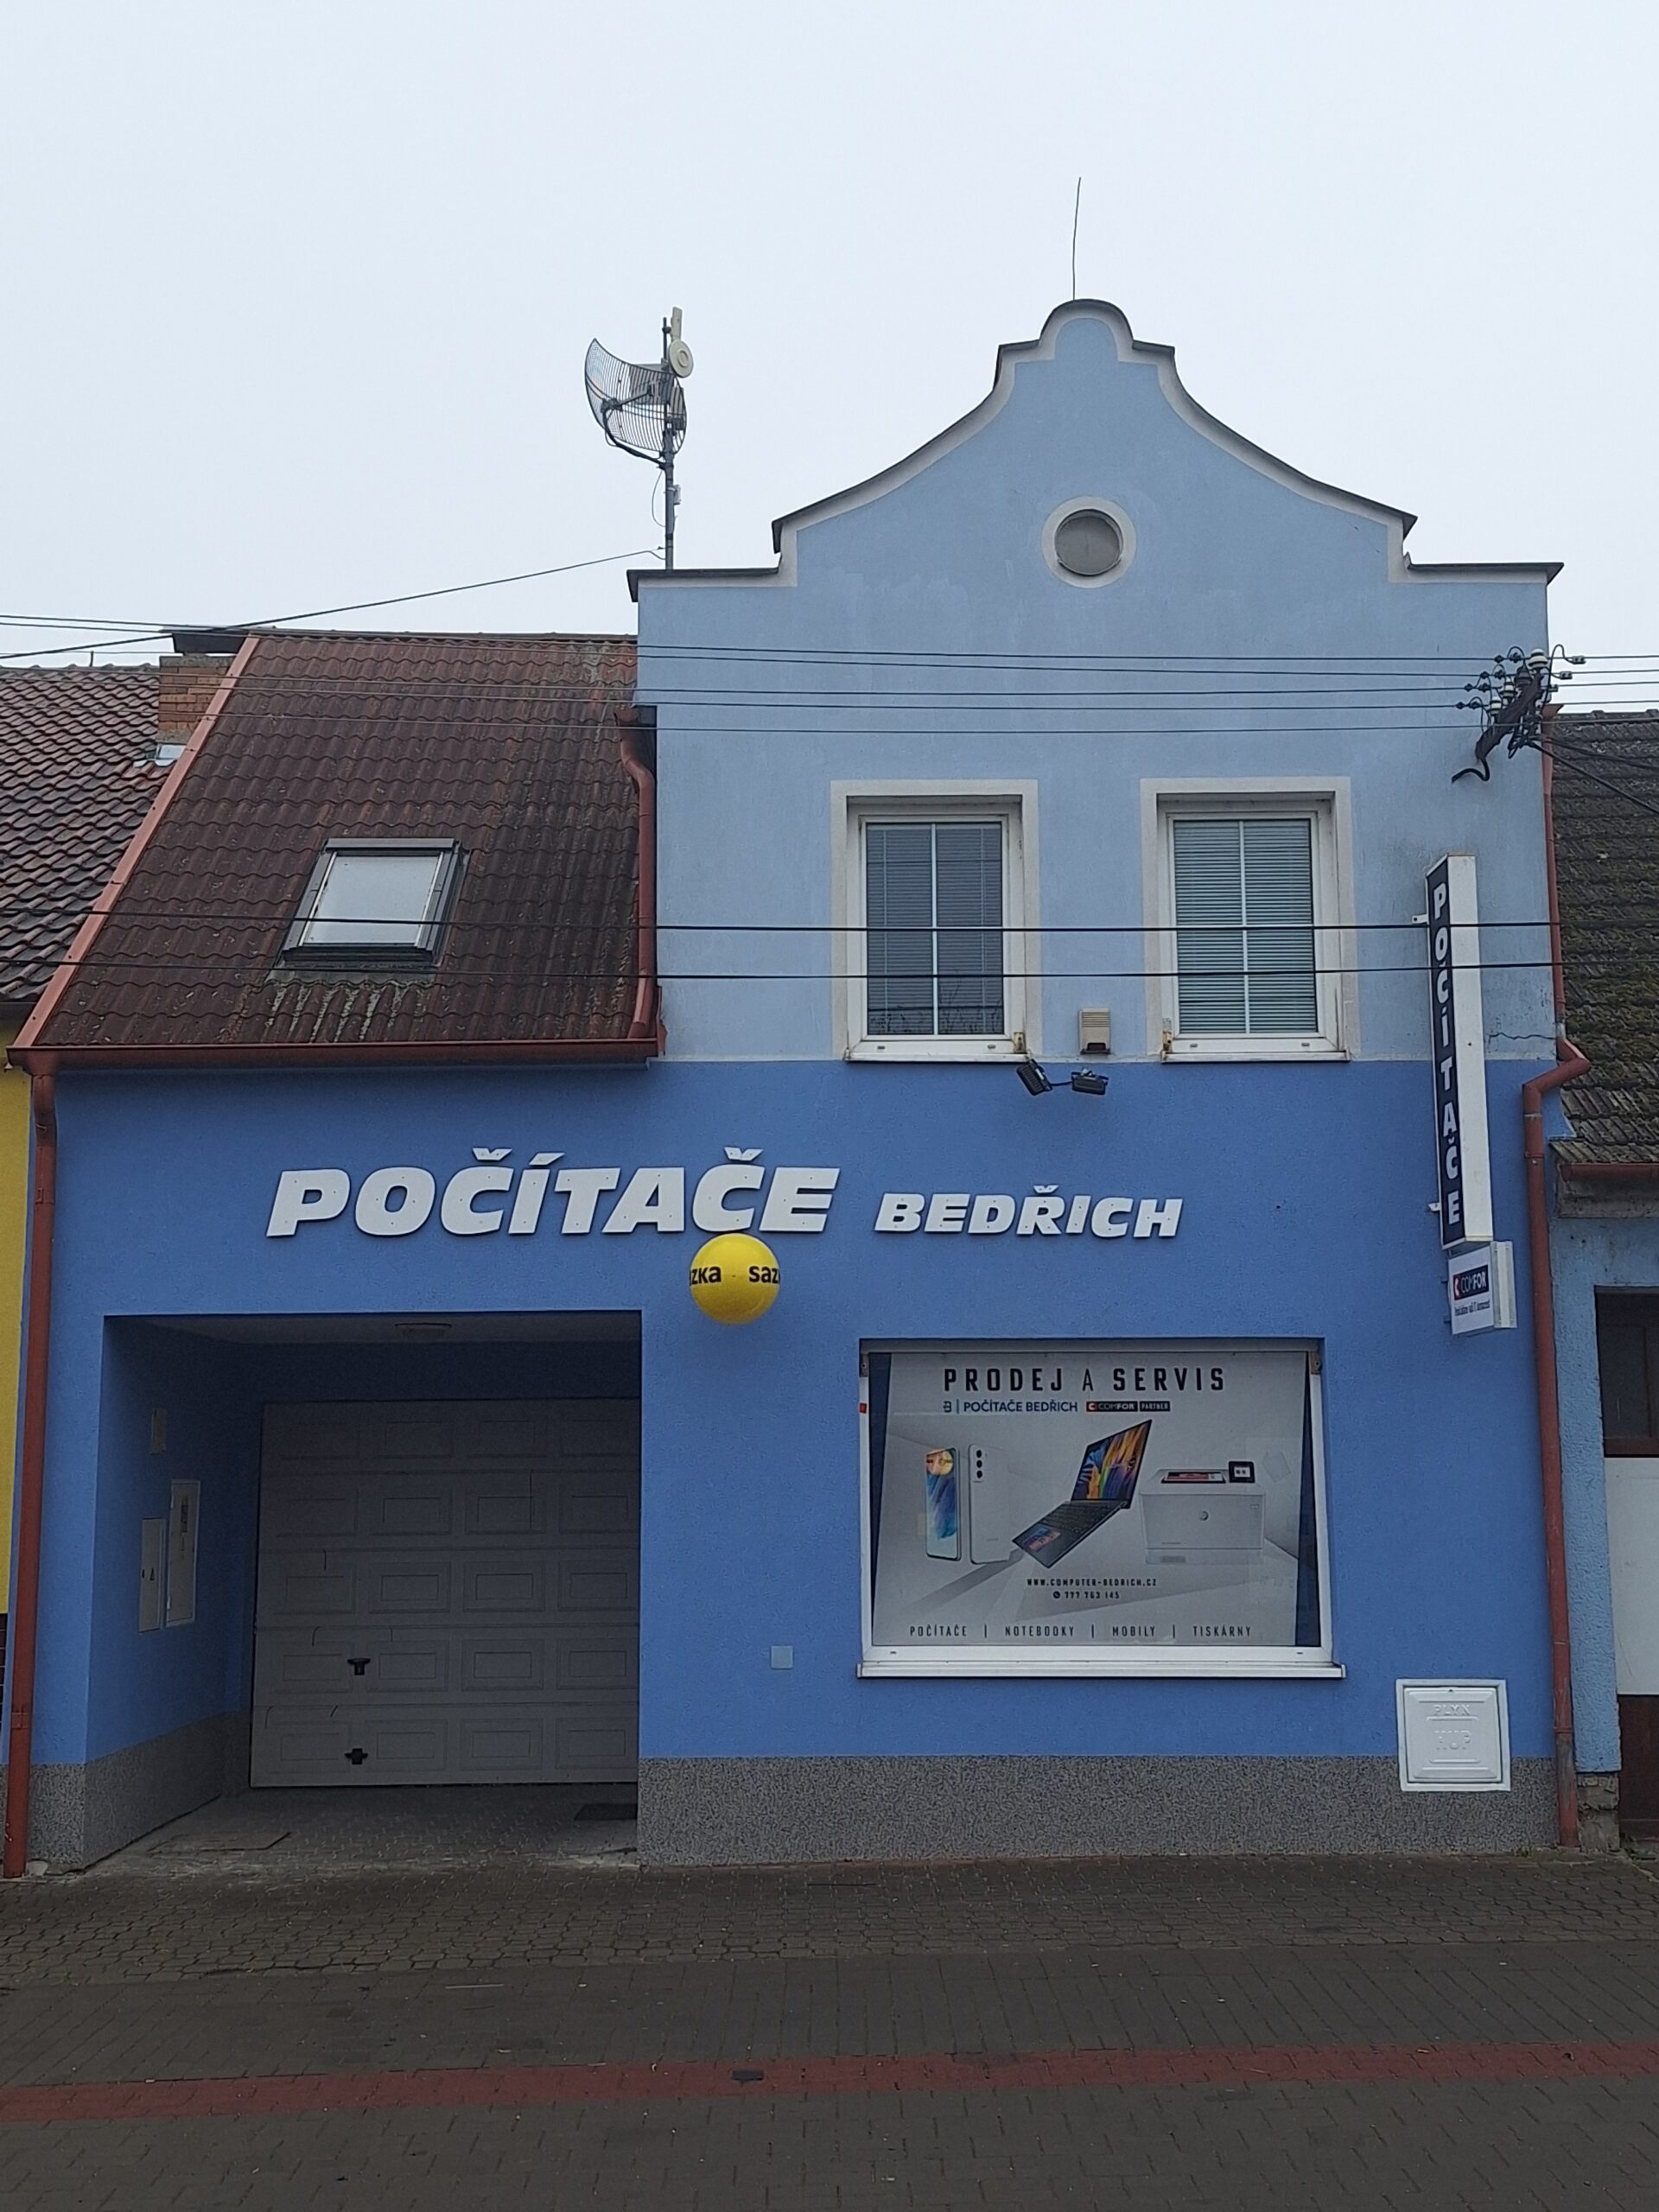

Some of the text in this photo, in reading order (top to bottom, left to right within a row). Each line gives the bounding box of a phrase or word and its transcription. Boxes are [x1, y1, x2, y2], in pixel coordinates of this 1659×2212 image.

[266, 1146, 1183, 1238] POČÍTAČE BEDŘICH
[748, 1265, 780, 1285] saz
[944, 1367, 1224, 1391] PRODEJ A SERVIS
[963, 1399, 1022, 1413] POČÍTAČE
[1026, 1399, 1078, 1413] BEDŘICH
[910, 1624, 1251, 1637] POČÍTAČE NOTEBOOKY MOBILY TISKÁRNY
